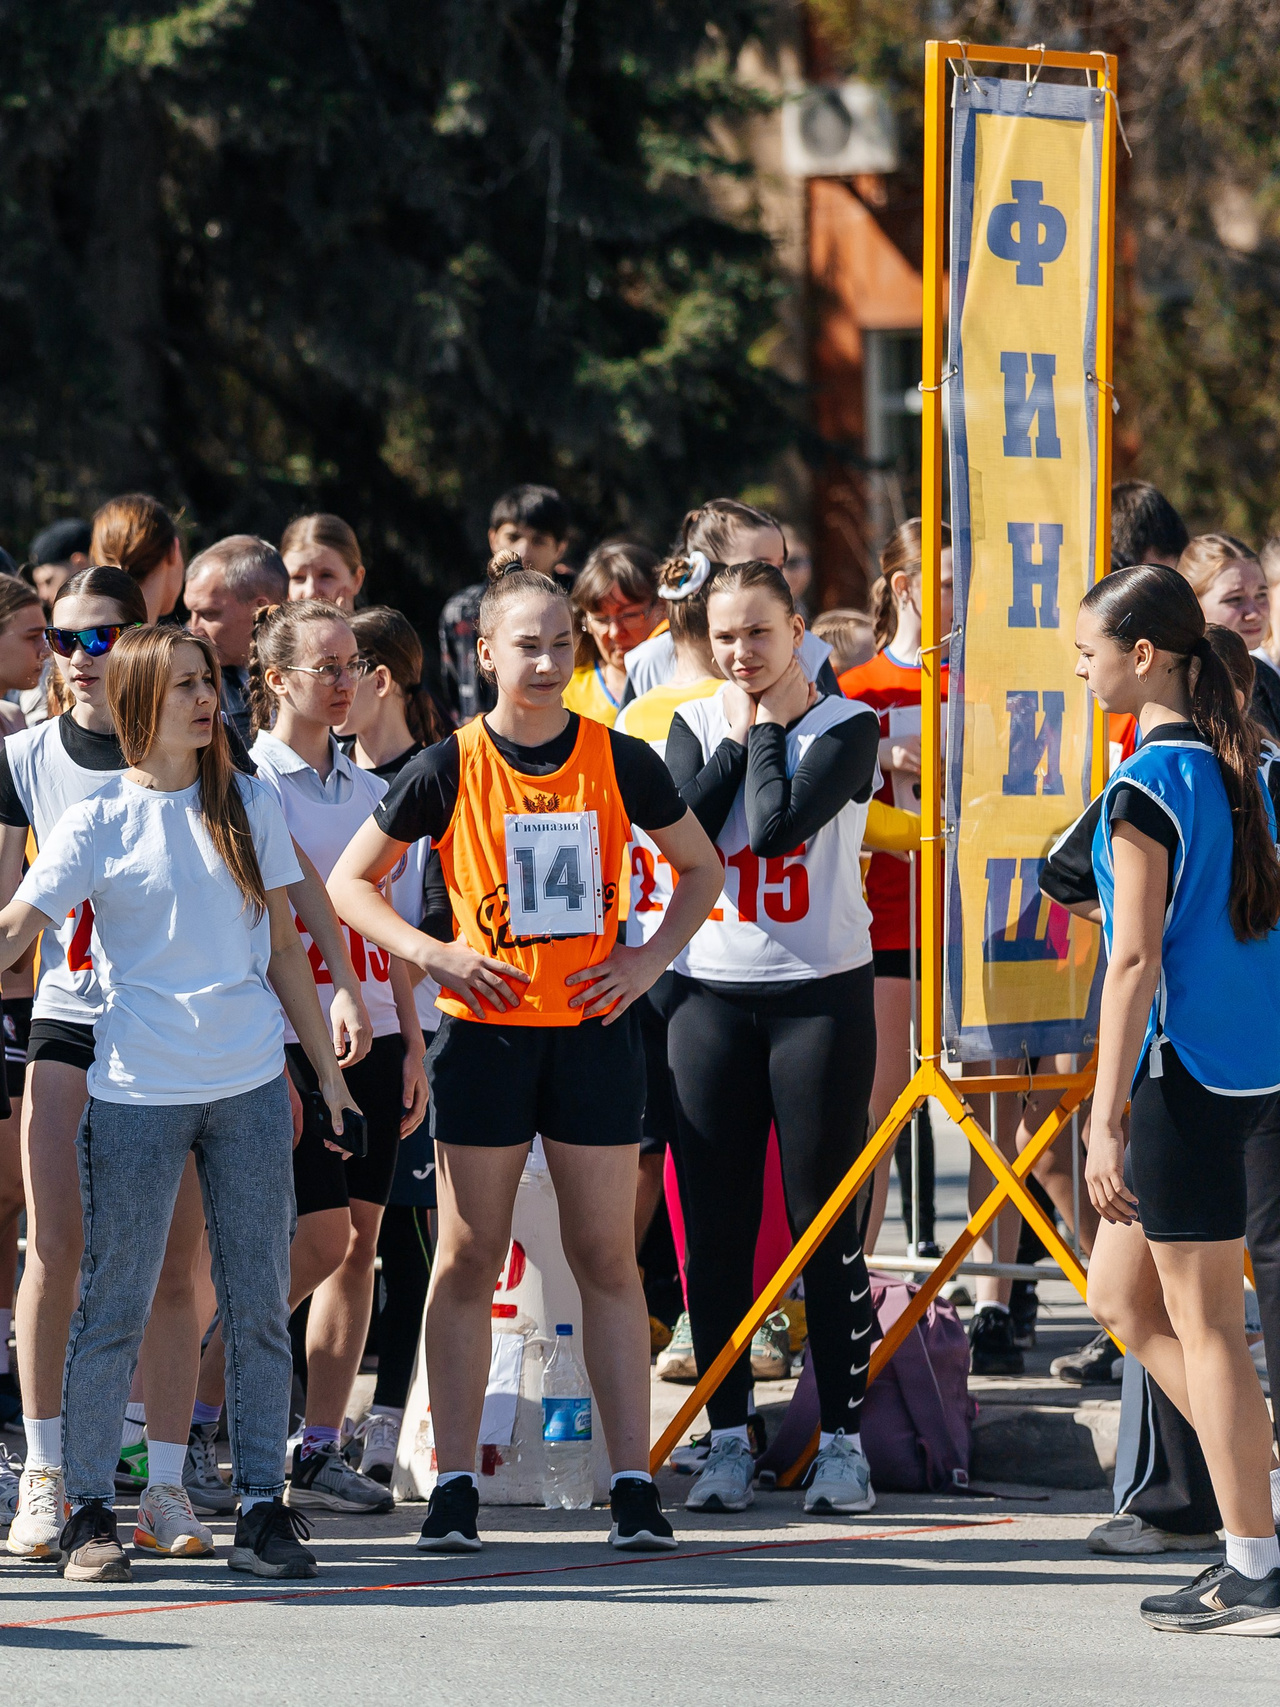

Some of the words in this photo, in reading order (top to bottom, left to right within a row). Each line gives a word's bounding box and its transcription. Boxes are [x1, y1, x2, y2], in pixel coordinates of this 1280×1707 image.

[982, 180, 1071, 963] ФИНИШ
[514, 821, 580, 834] Гимназия
[513, 844, 587, 914] 14
